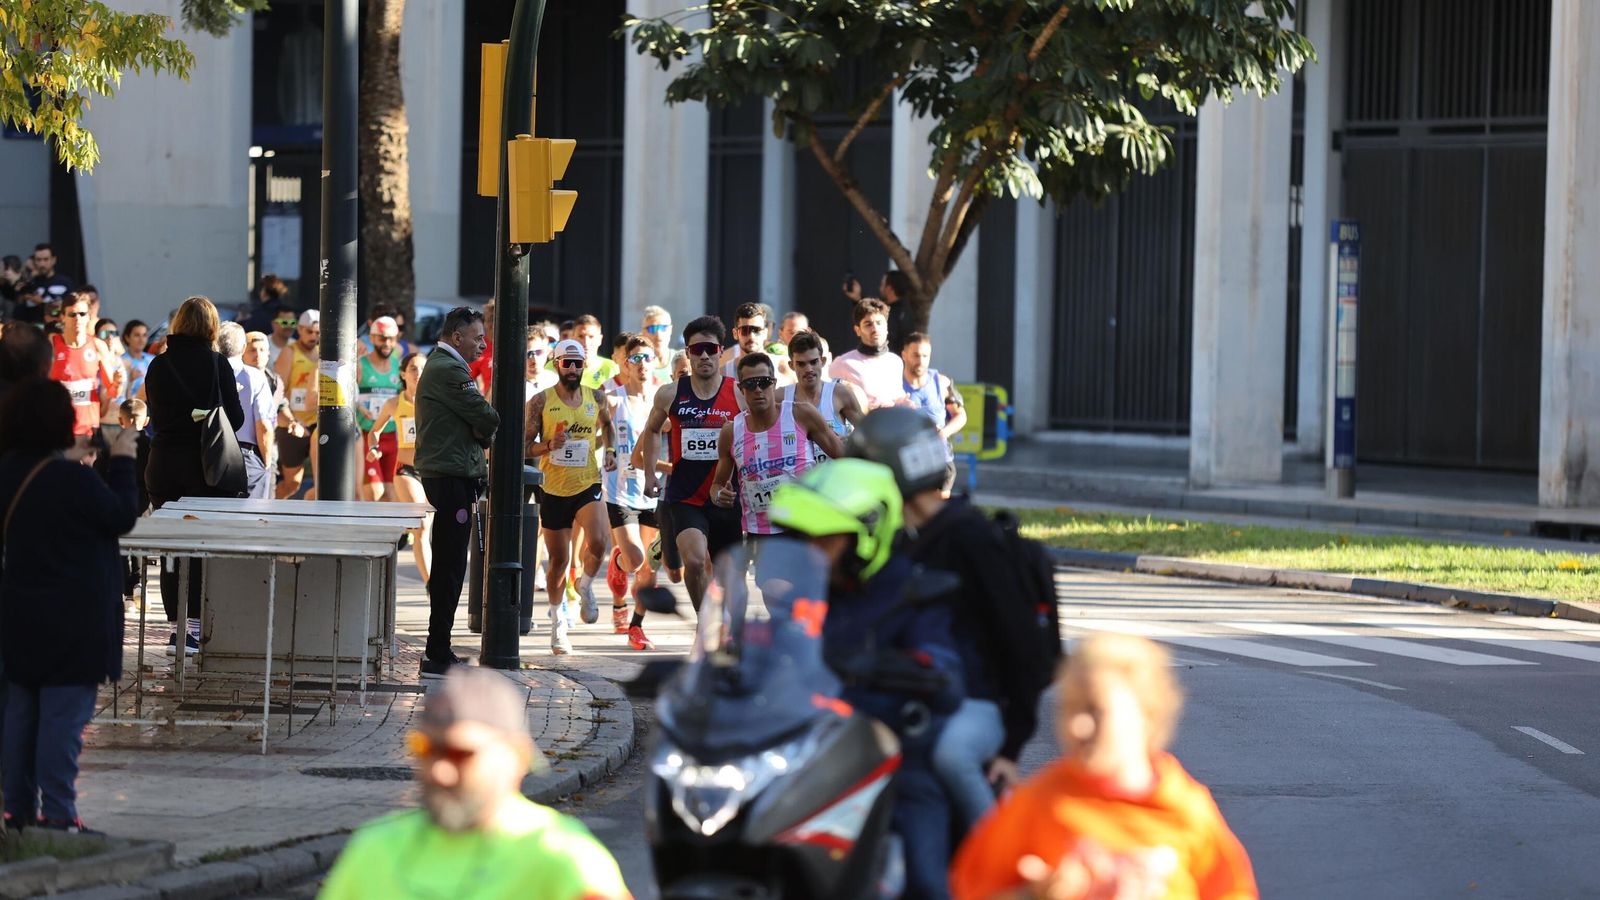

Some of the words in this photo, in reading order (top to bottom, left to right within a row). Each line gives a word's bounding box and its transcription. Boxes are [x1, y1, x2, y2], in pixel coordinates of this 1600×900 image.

[1340, 223, 1360, 241] BUS
[677, 407, 698, 415] RFC
[687, 440, 717, 451] 694
[564, 449, 573, 459] 5
